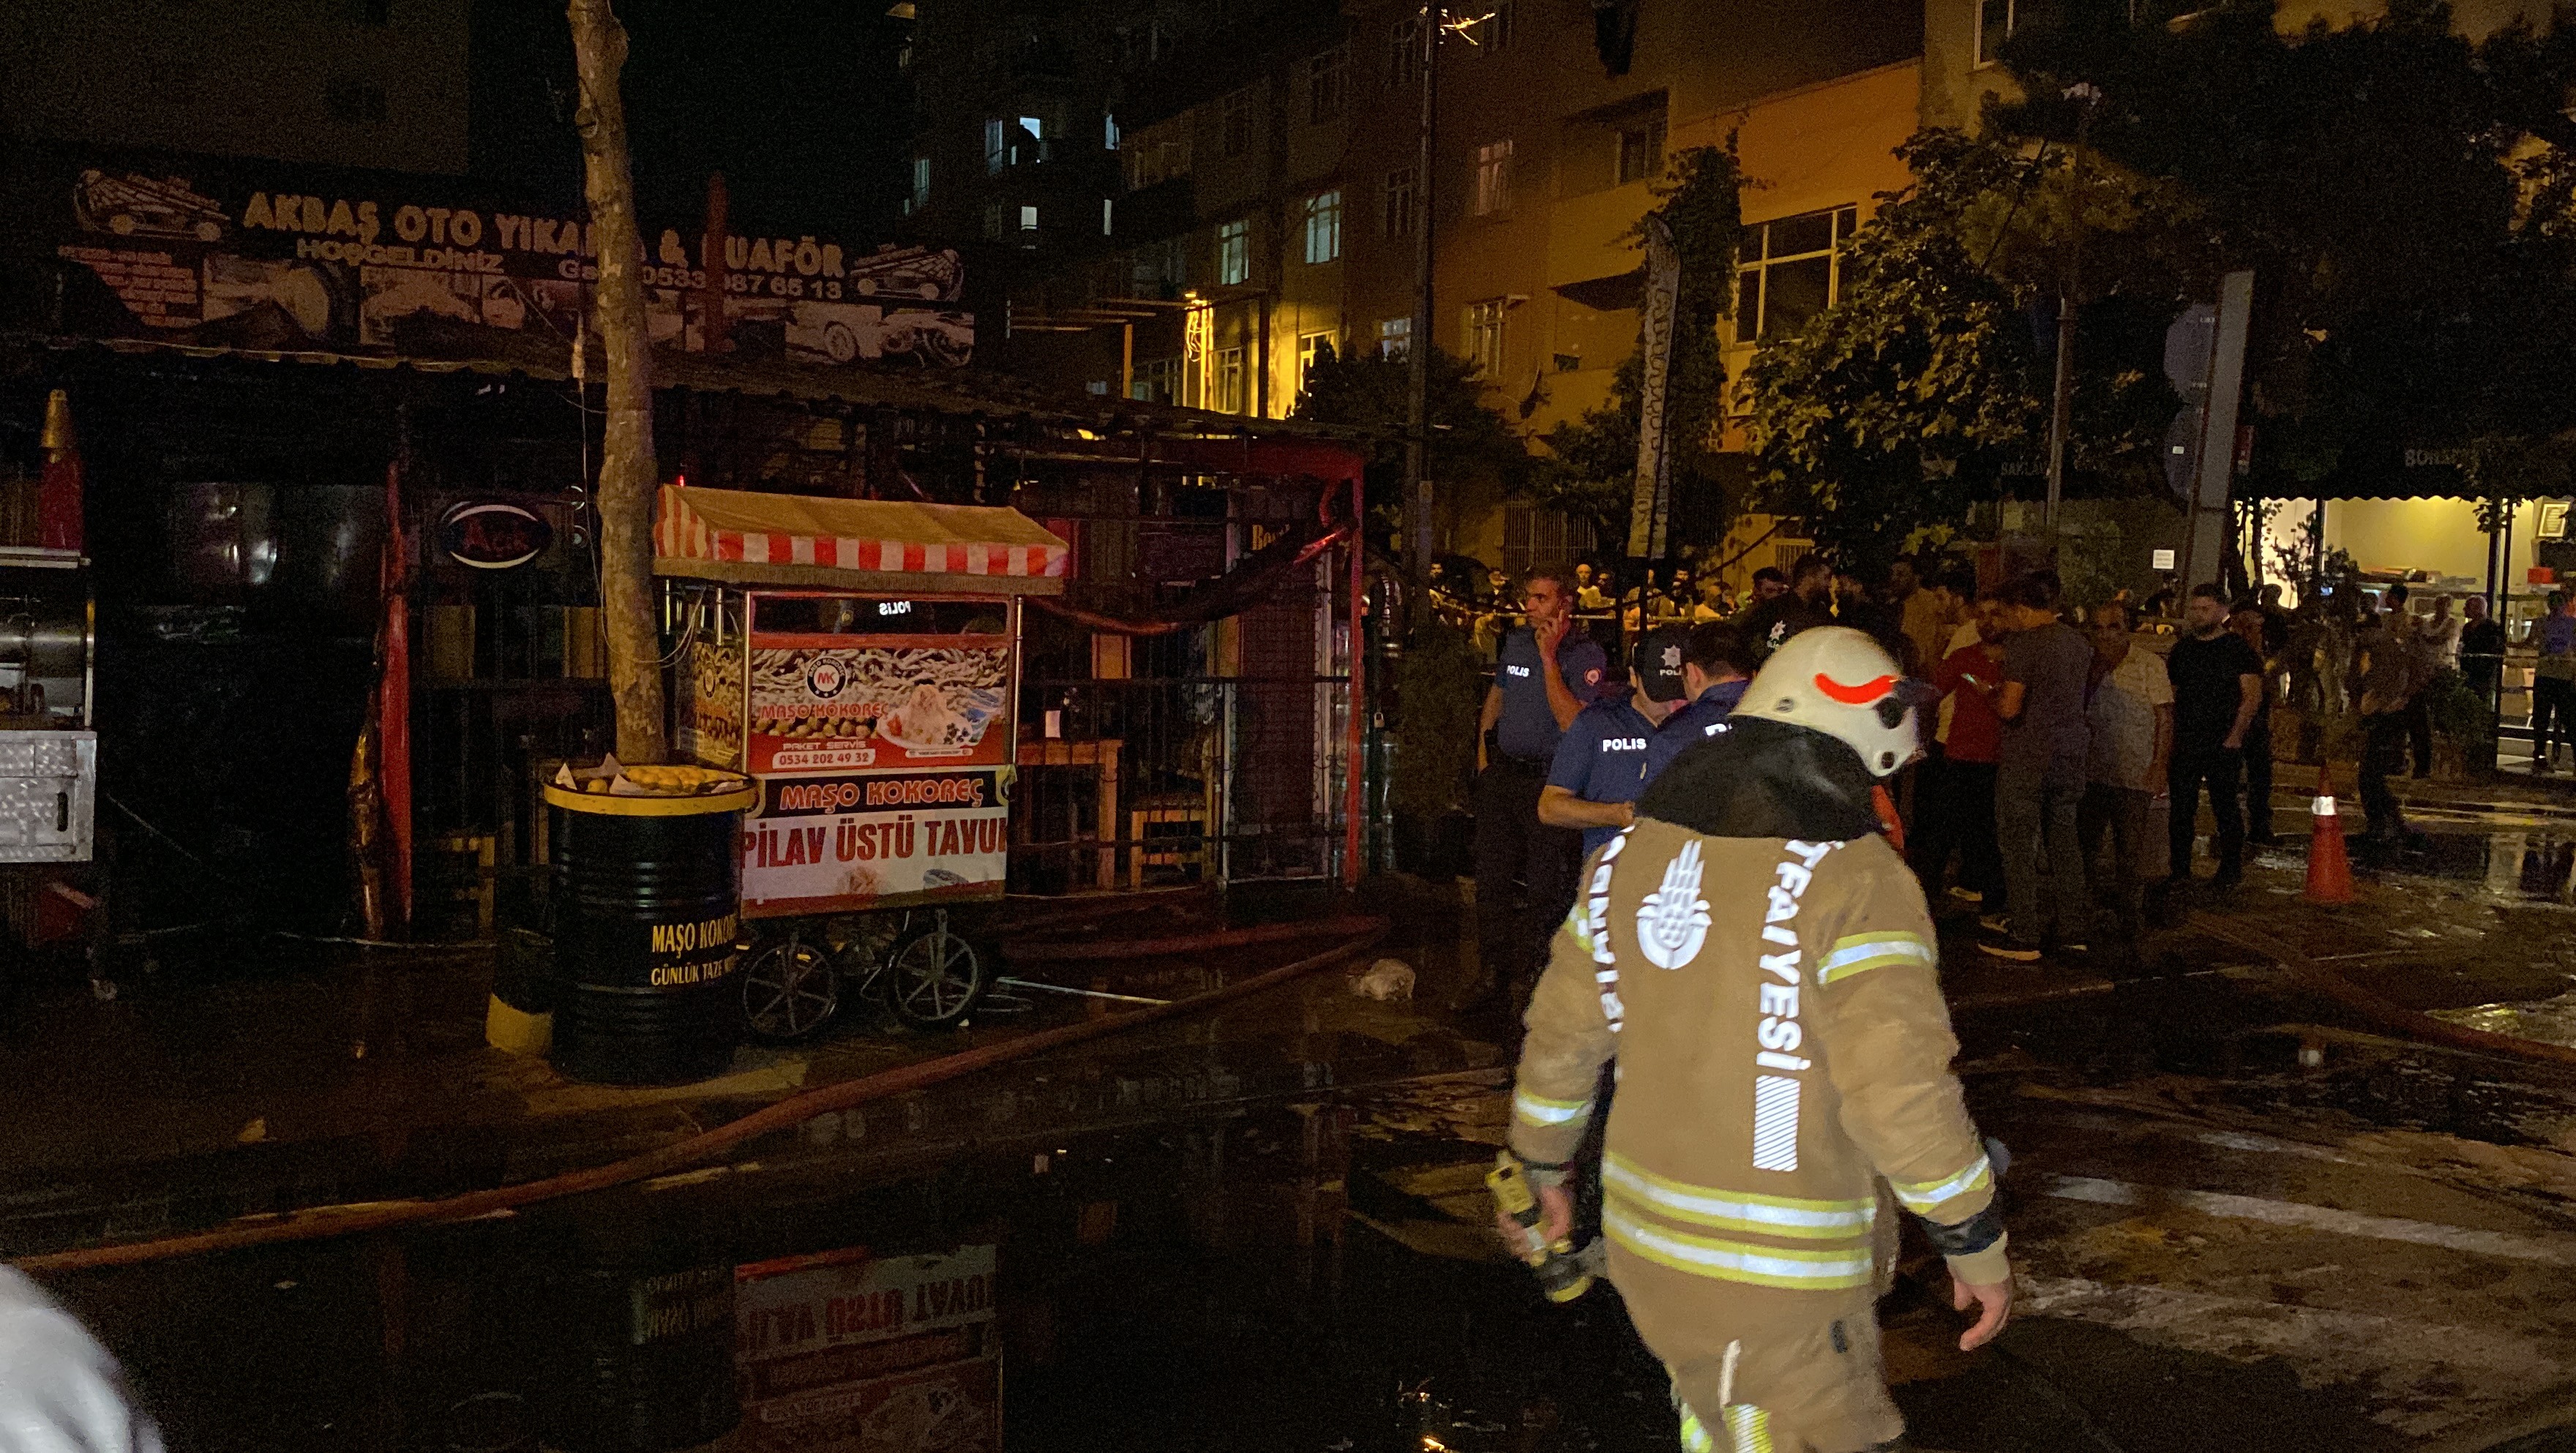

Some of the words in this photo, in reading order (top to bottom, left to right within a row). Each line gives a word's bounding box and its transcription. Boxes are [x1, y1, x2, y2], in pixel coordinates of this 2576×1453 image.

[243, 191, 381, 245] AKBAŞ
[394, 203, 483, 247] OTO
[702, 233, 844, 278] UAFÖR
[809, 280, 843, 300] 13
[817, 672, 836, 685] MK
[760, 704, 810, 724] MAŞO
[782, 742, 822, 751] PAKET
[779, 754, 809, 766] 0534
[812, 753, 834, 765] 202
[836, 752, 852, 764] 49
[855, 751, 869, 763] 32
[779, 782, 860, 814] MAŞO
[866, 778, 984, 808] KOKOREÇ
[739, 822, 827, 869] PİLAV
[836, 814, 916, 863] ÜSTÜ
[651, 922, 696, 959] MAŞO
[651, 962, 700, 986] GÜNLÜK
